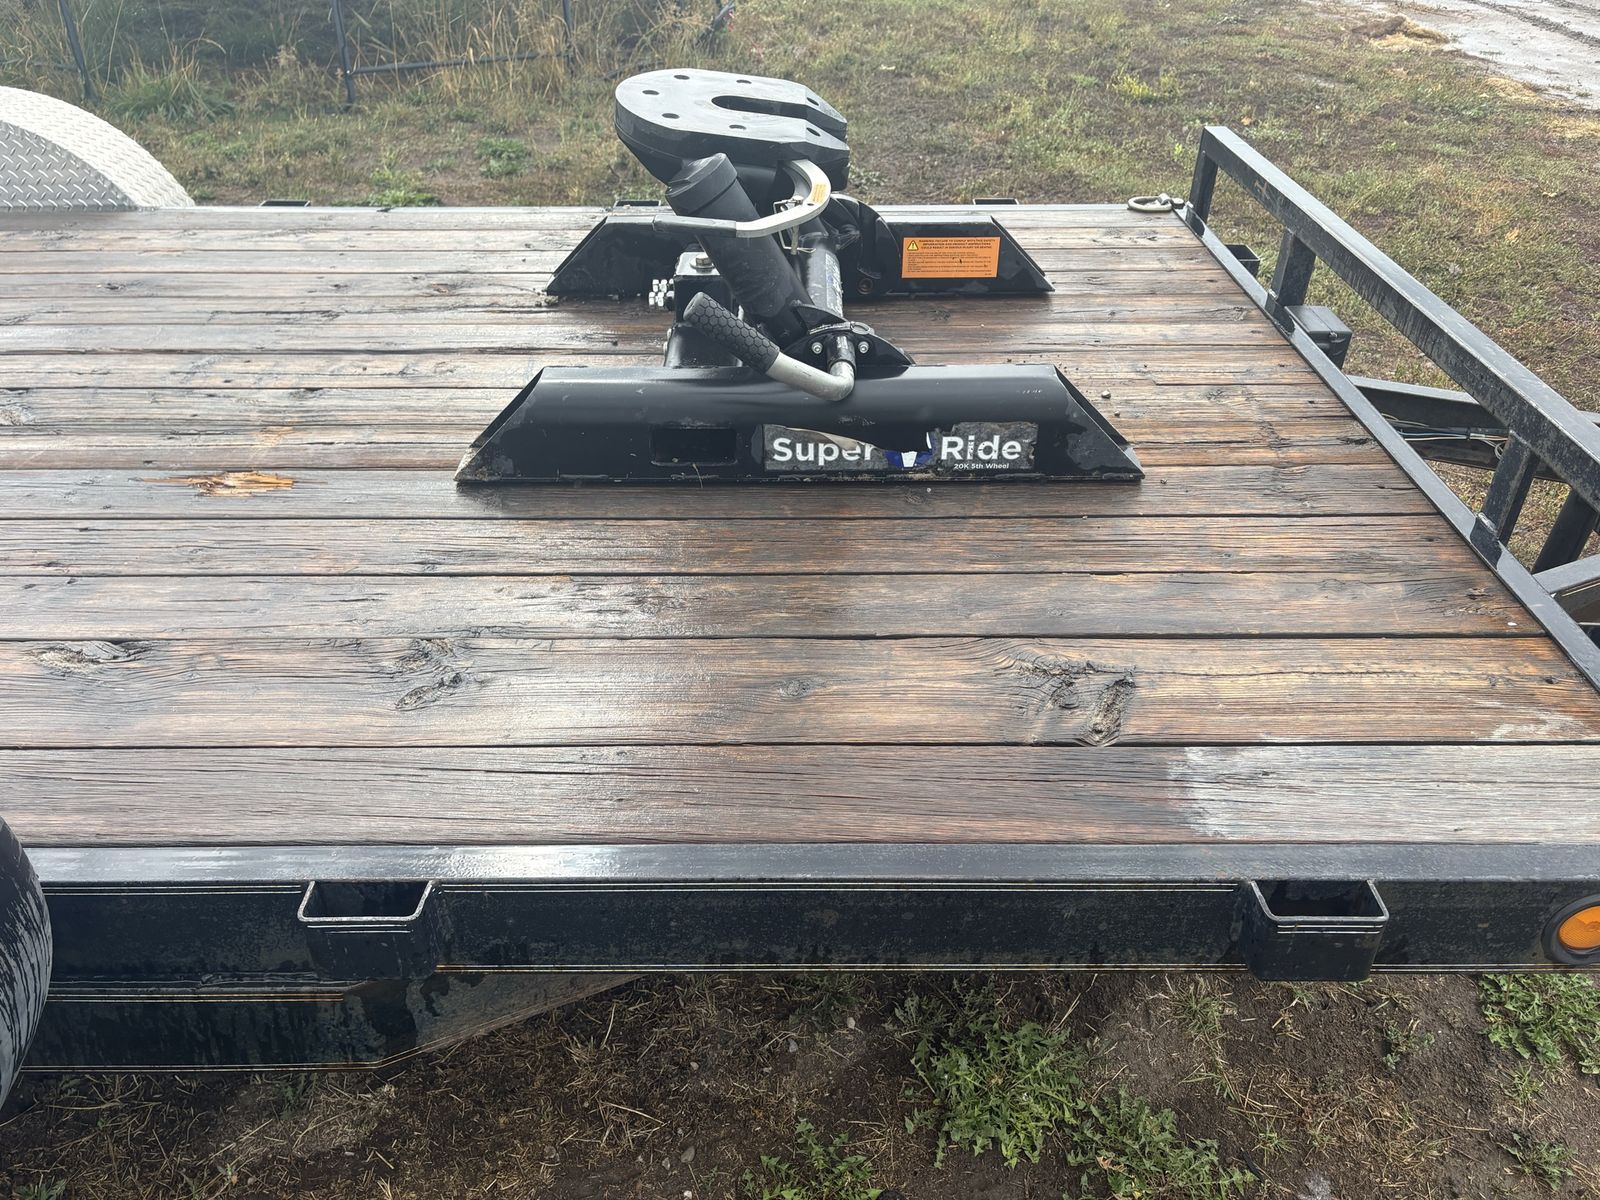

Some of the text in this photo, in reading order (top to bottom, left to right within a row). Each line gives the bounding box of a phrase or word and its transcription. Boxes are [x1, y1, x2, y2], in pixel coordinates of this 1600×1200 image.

[772, 435, 1022, 466] Super Ride
[953, 462, 1010, 470] 20K 5th Wheel
